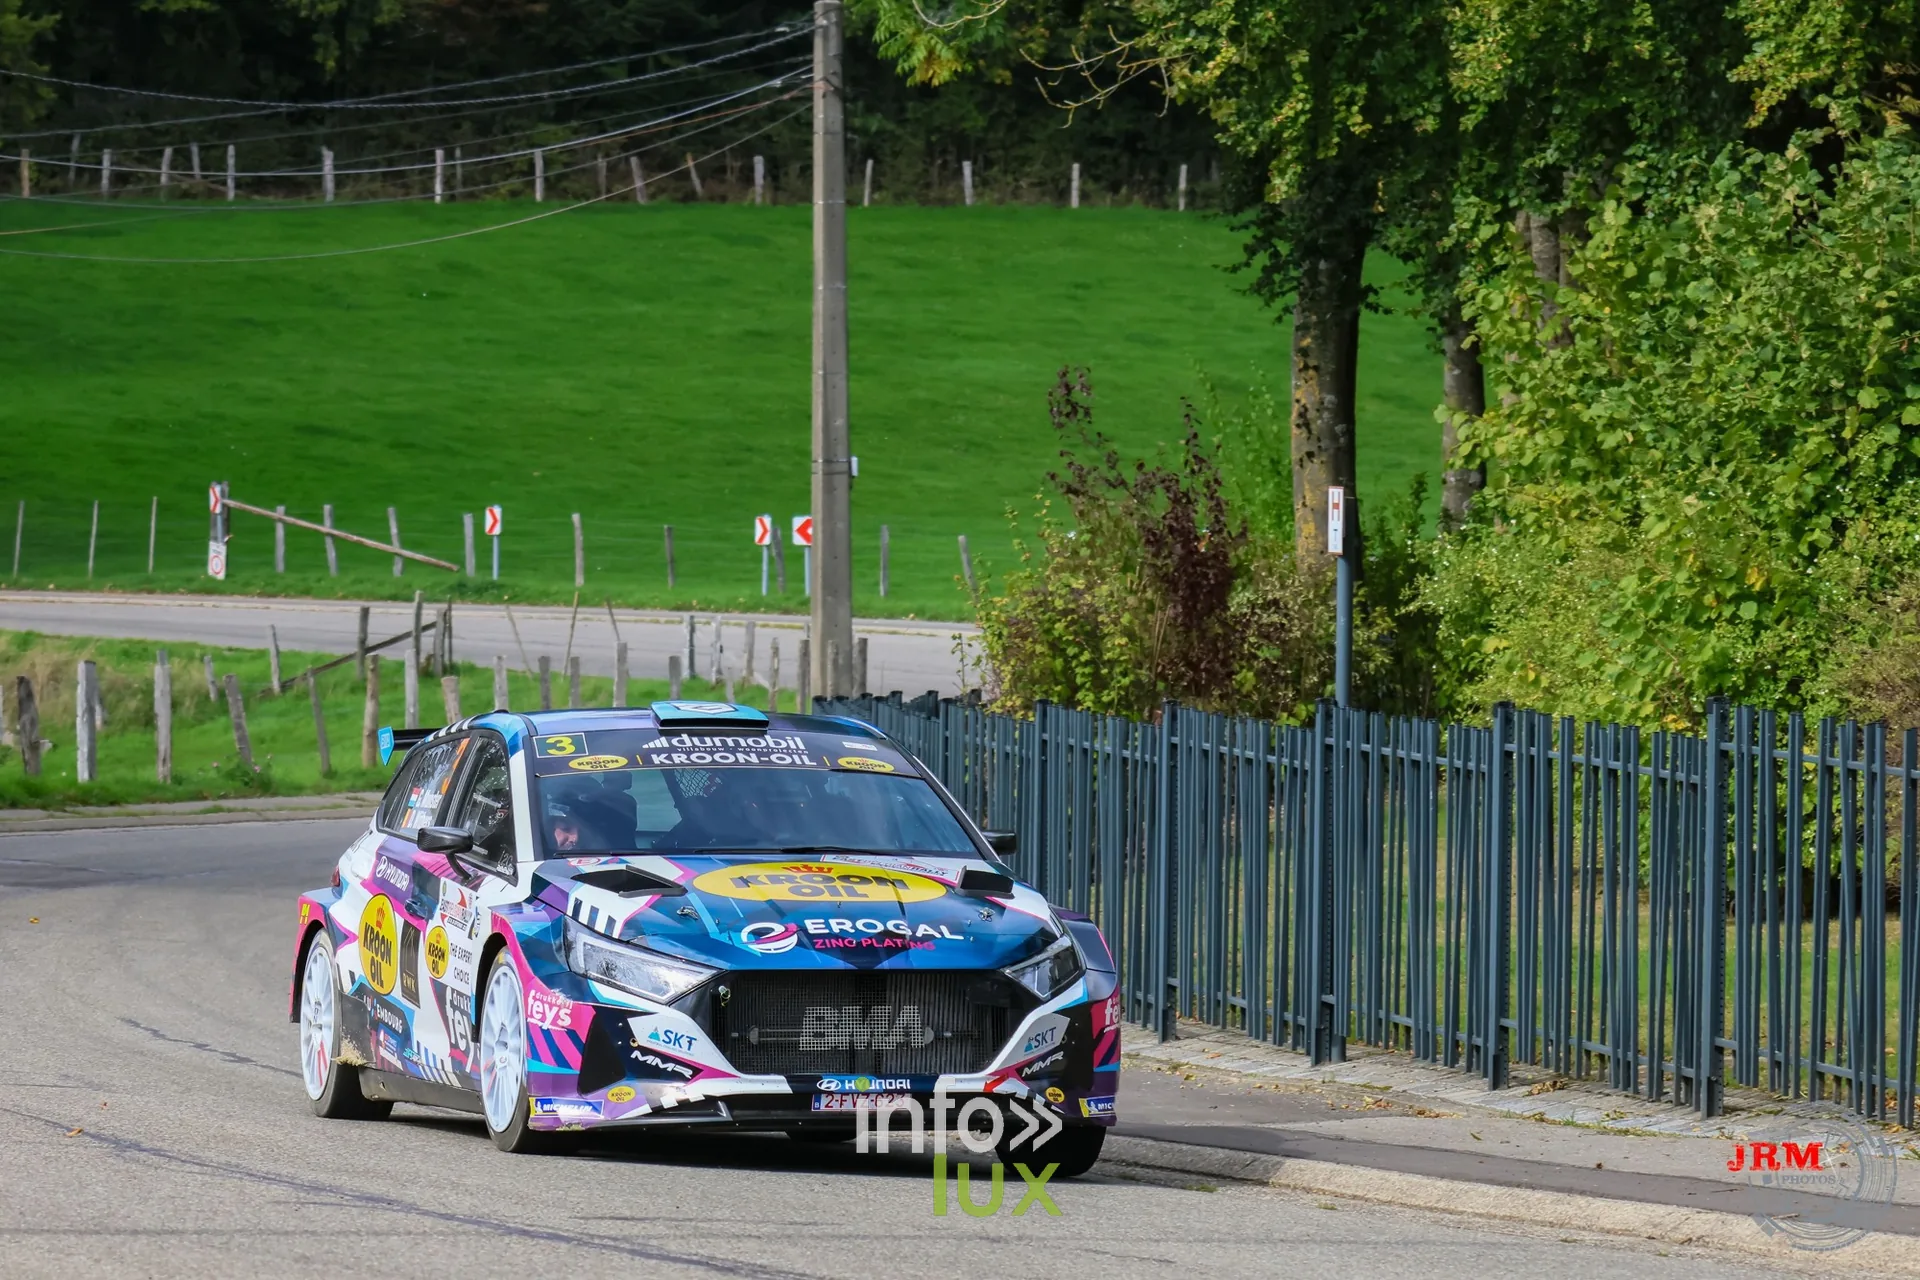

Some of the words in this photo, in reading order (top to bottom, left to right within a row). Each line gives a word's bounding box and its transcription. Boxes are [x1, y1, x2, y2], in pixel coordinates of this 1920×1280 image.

[546, 736, 576, 755] 3
[671, 733, 806, 750] dumobil
[650, 752, 817, 766] KROON-OIL
[845, 760, 887, 769] KROON
[729, 873, 910, 890] KROON
[787, 884, 869, 898] OIL
[803, 918, 965, 941] EROGAL
[363, 922, 392, 967] KROON
[428, 942, 446, 963] KROON
[862, 938, 936, 951] PLATING
[370, 956, 384, 989] OIL
[431, 959, 440, 975] OIL
[454, 967, 470, 984] CHOICE
[527, 989, 572, 1030] feys
[799, 1005, 925, 1050] BMA
[1034, 1026, 1057, 1048] SKT
[662, 1029, 697, 1051] SKT
[630, 1050, 693, 1079] MMR
[1021, 1051, 1064, 1077] MMR
[543, 1103, 593, 1112] MICHELIN
